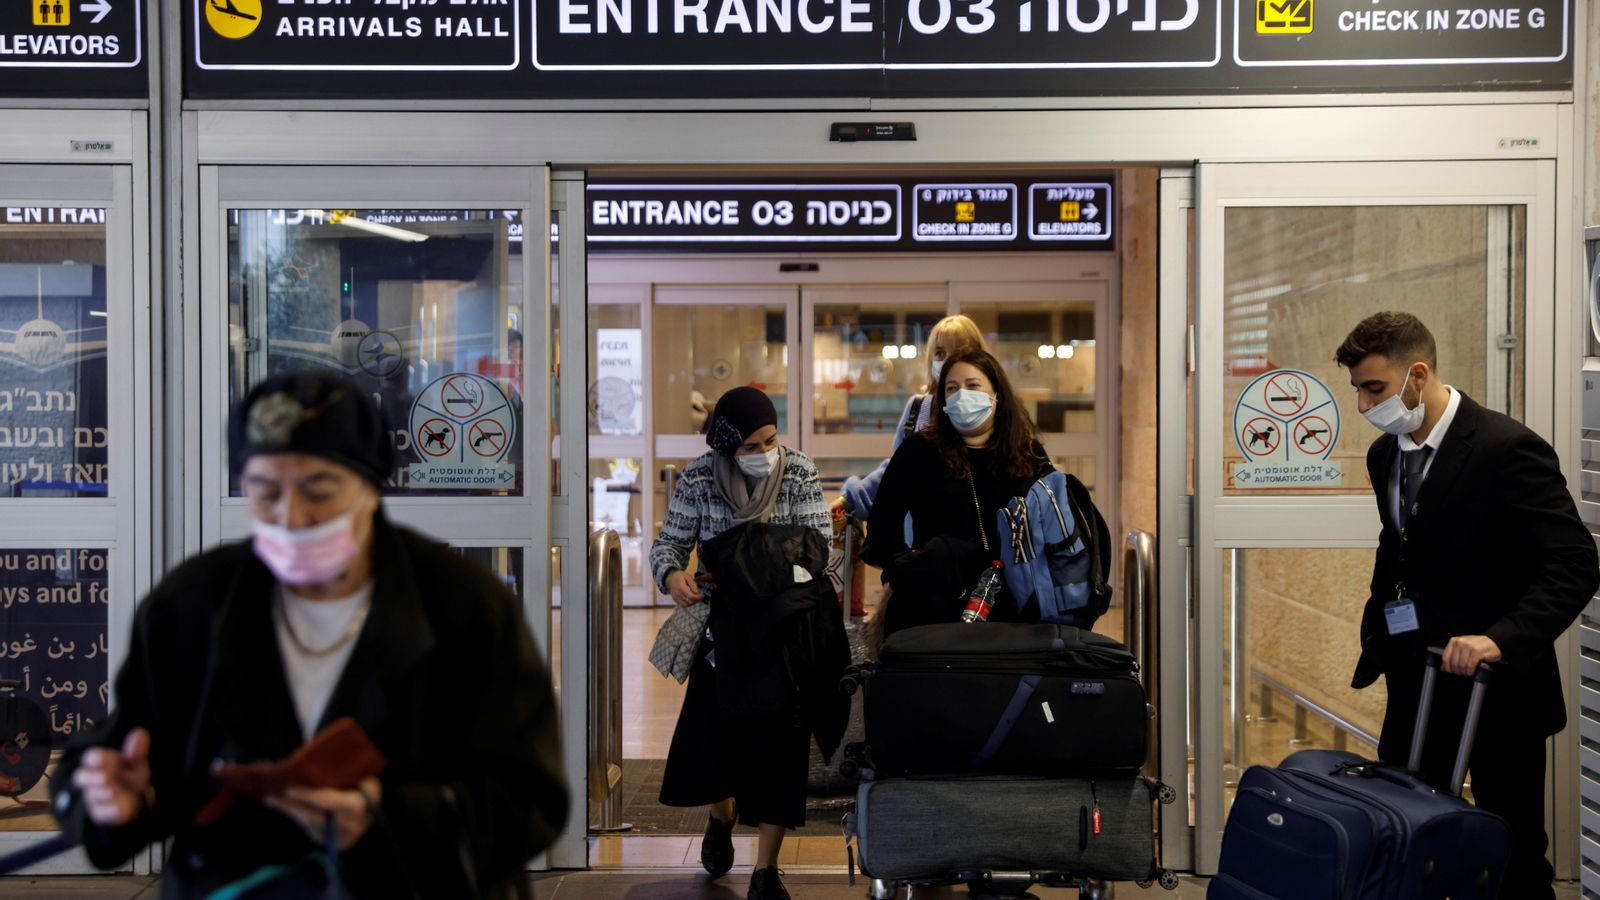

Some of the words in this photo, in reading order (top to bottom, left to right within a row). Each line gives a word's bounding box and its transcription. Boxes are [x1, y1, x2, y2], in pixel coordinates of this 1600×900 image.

[275, 16, 422, 37] ARRIVALS
[435, 17, 509, 37] HALL
[558, 0, 874, 34] ENTRANCE
[907, 0, 996, 35] 03
[1338, 11, 1419, 32] CHECK
[1426, 11, 1449, 31] IN
[1456, 9, 1520, 30] ZONE
[1528, 8, 1545, 28] G
[936, 189, 972, 204] בידוק
[976, 189, 1008, 202] מגזר
[1046, 187, 1095, 201] מעליות
[592, 200, 739, 225] ENTRANCE
[751, 200, 794, 226] 03
[806, 200, 892, 225] כניסה
[918, 223, 956, 235] CHECK
[958, 223, 970, 234] IN
[971, 223, 1001, 234] ZONE
[1002, 223, 1012, 235] G
[1038, 222, 1102, 234] ELEVATORS
[1255, 475, 1298, 483] AUTOMATIC
[0, 554, 19, 571] u
[26, 549, 71, 571] and
[78, 549, 108, 571] fo
[0, 586, 30, 608] ys
[36, 582, 81, 604] and
[47, 636, 75, 660] بن
[40, 676, 88, 699] ومن
